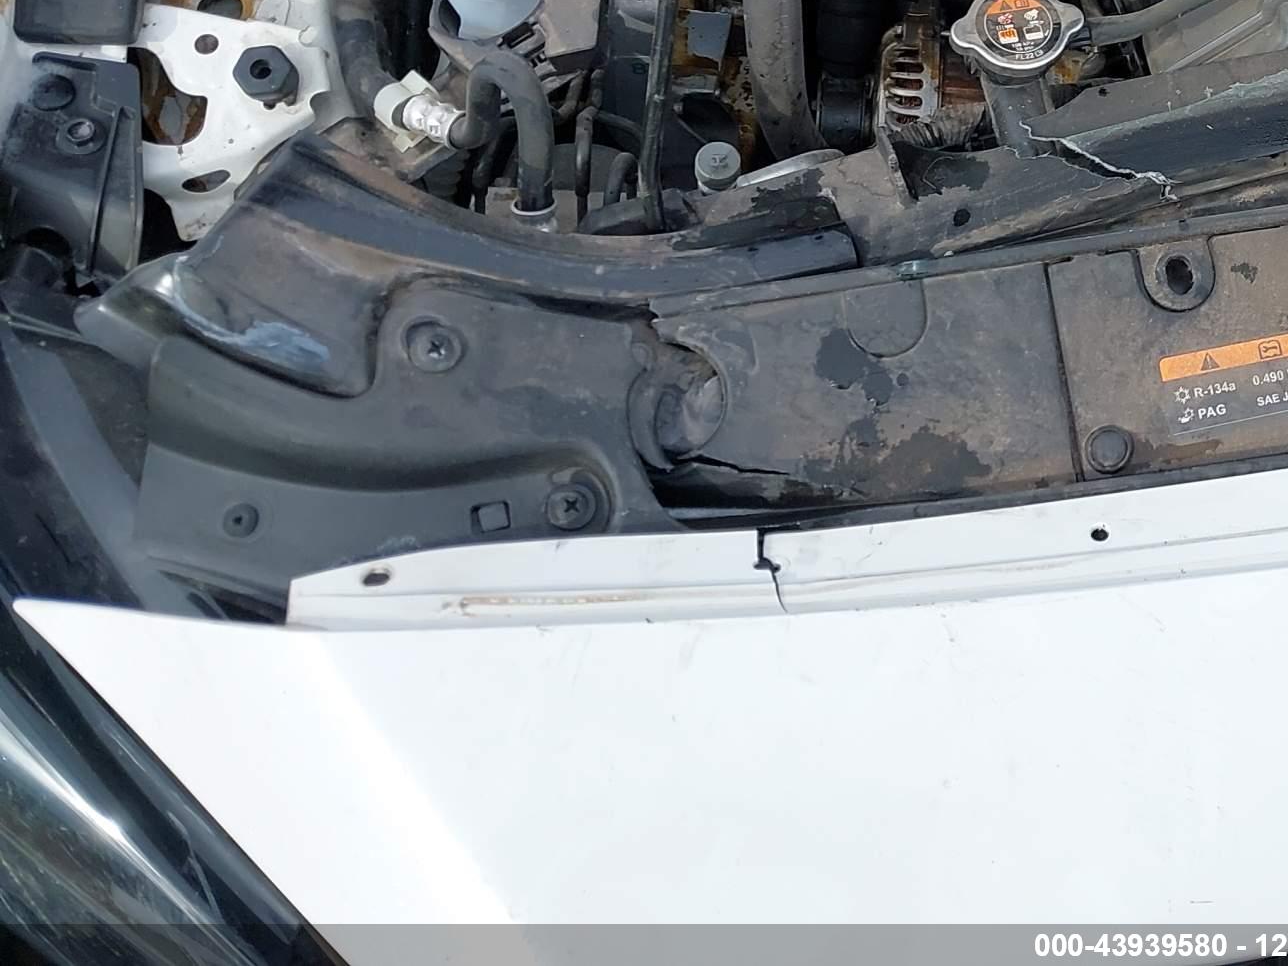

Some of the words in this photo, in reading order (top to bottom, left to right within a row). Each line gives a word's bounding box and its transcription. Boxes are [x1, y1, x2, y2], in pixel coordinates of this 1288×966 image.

[1193, 382, 1236, 398] R-134a
[1252, 371, 1284, 386] 0.490
[1197, 404, 1227, 419] PAG
[1256, 392, 1281, 407] SAE
